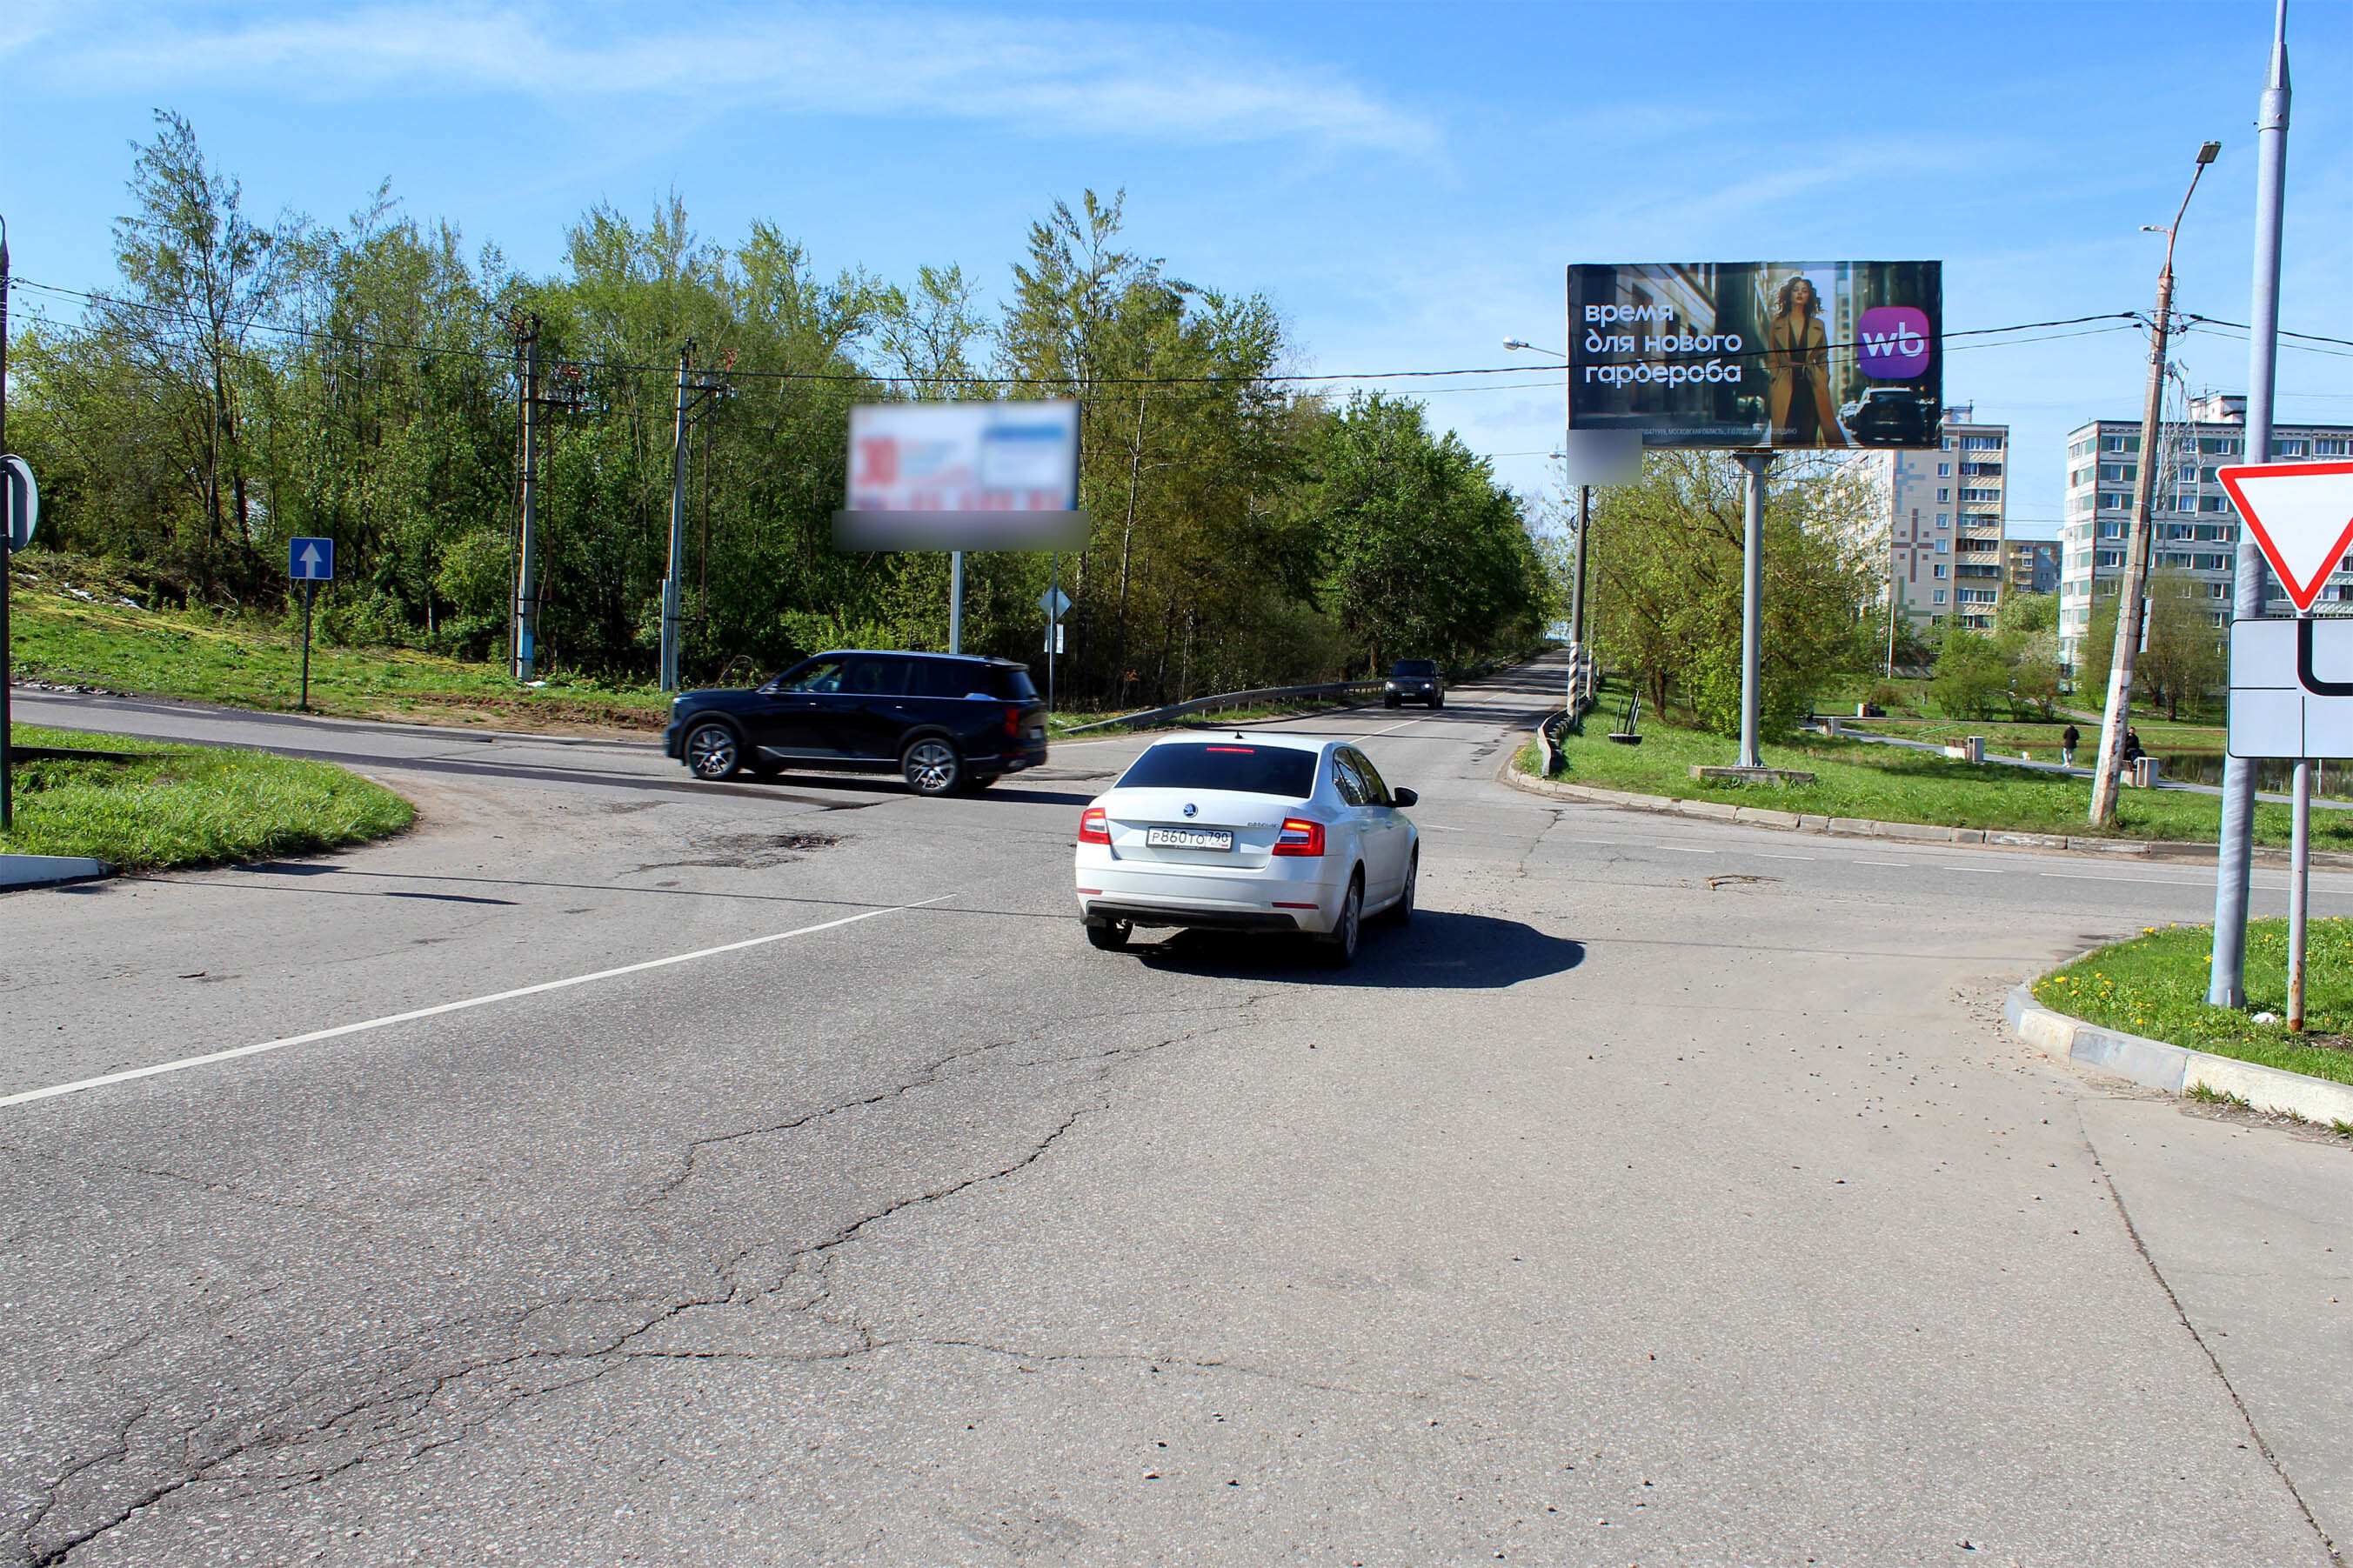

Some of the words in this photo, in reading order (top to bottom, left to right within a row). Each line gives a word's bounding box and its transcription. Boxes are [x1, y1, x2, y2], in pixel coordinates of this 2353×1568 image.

[1585, 304, 1674, 328] время
[1585, 328, 1635, 353] для
[1644, 334, 1742, 353] нового
[1862, 322, 1925, 357] wb
[1585, 358, 1741, 390] гардероба
[1207, 831, 1228, 843] 790
